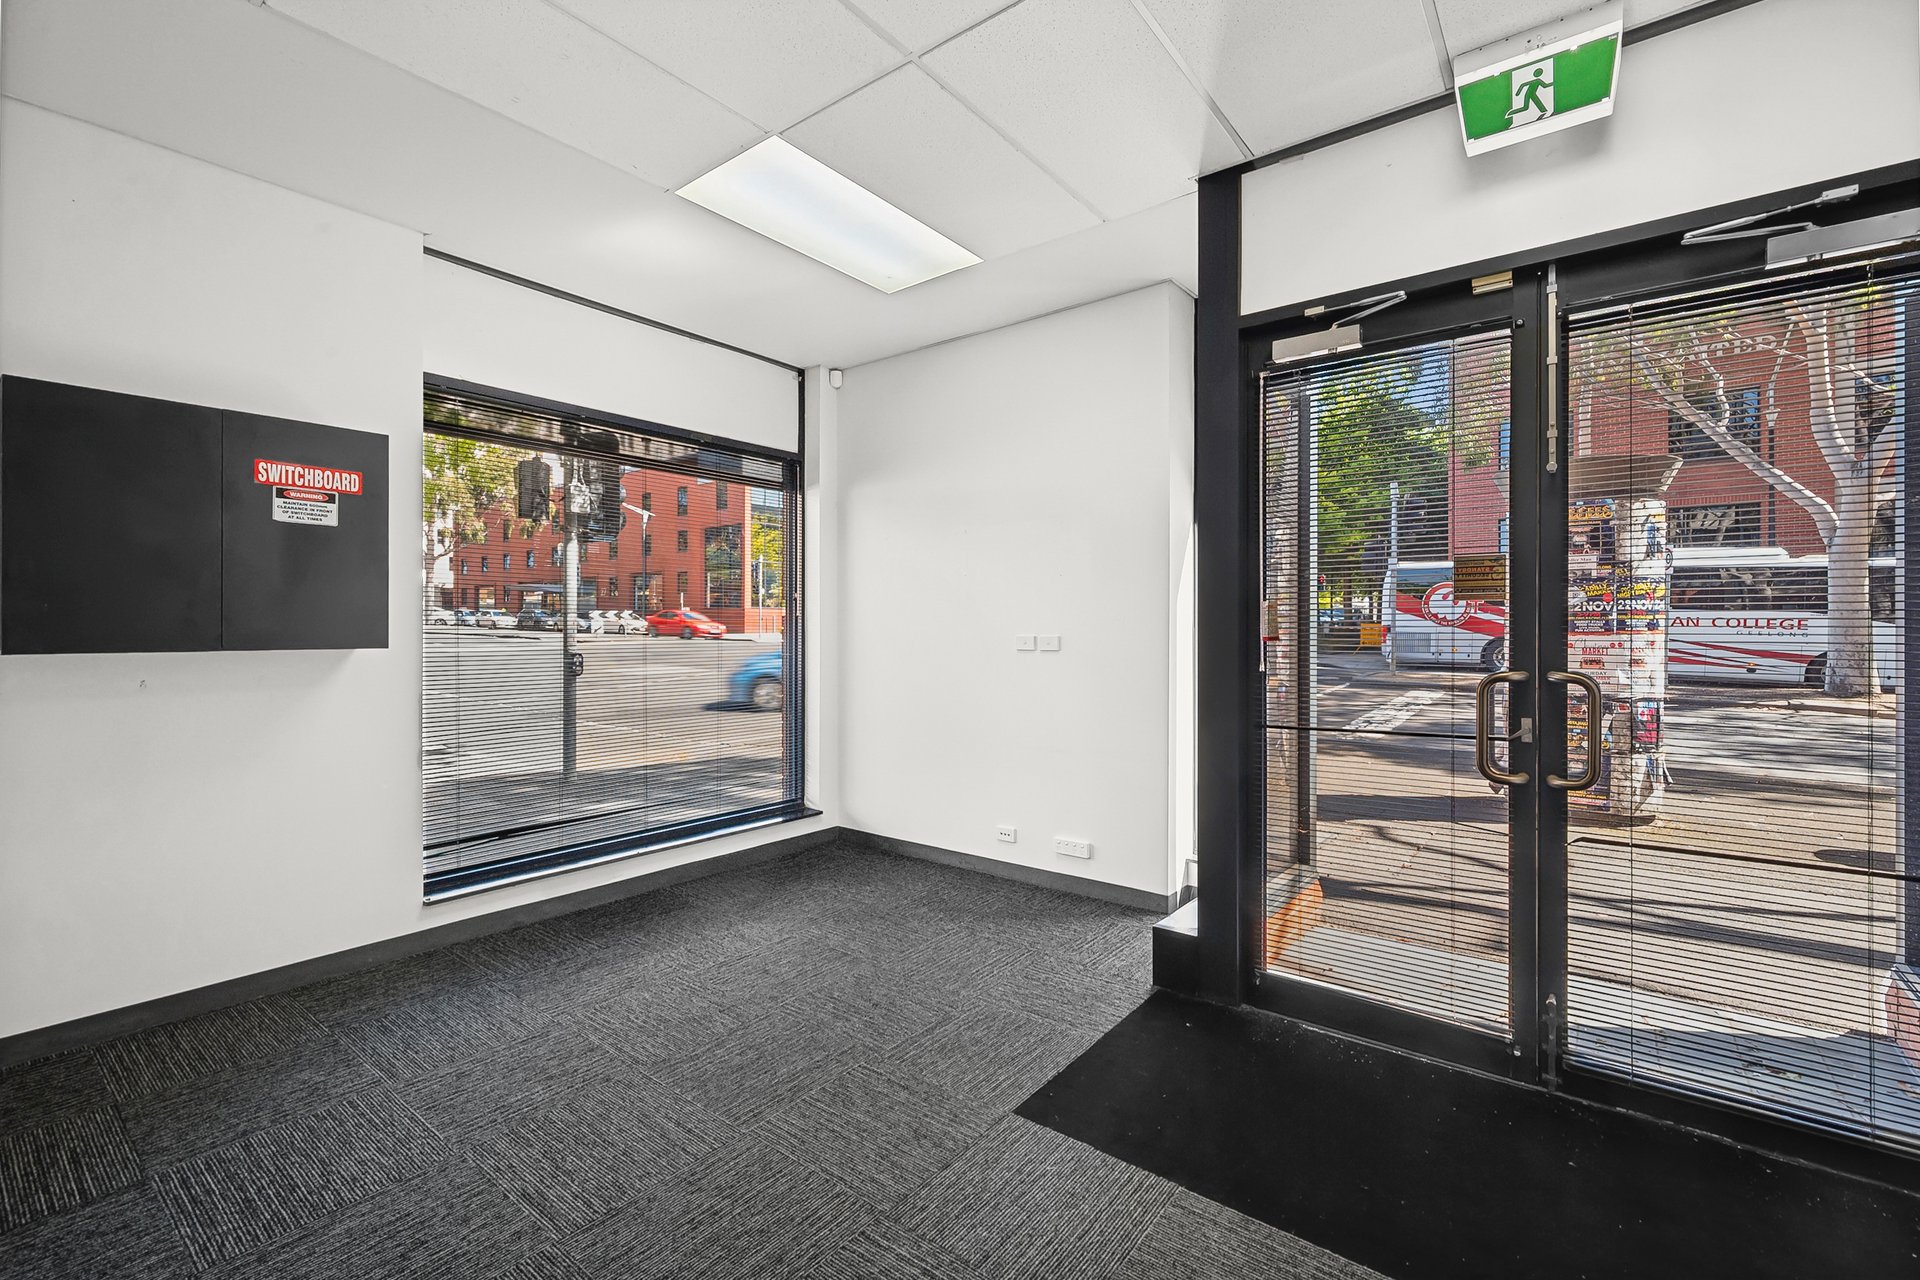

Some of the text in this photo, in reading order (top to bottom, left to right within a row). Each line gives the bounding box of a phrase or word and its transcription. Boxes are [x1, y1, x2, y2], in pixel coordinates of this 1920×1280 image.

[258, 461, 359, 492] SWITCHBOARD
[290, 492, 323, 500] WARNING
[276, 504, 308, 512] CLEARANCE
[290, 510, 329, 518] SWITCHBOARD
[1711, 616, 1809, 631] COLLEGE
[1580, 646, 1609, 656] MARKET
